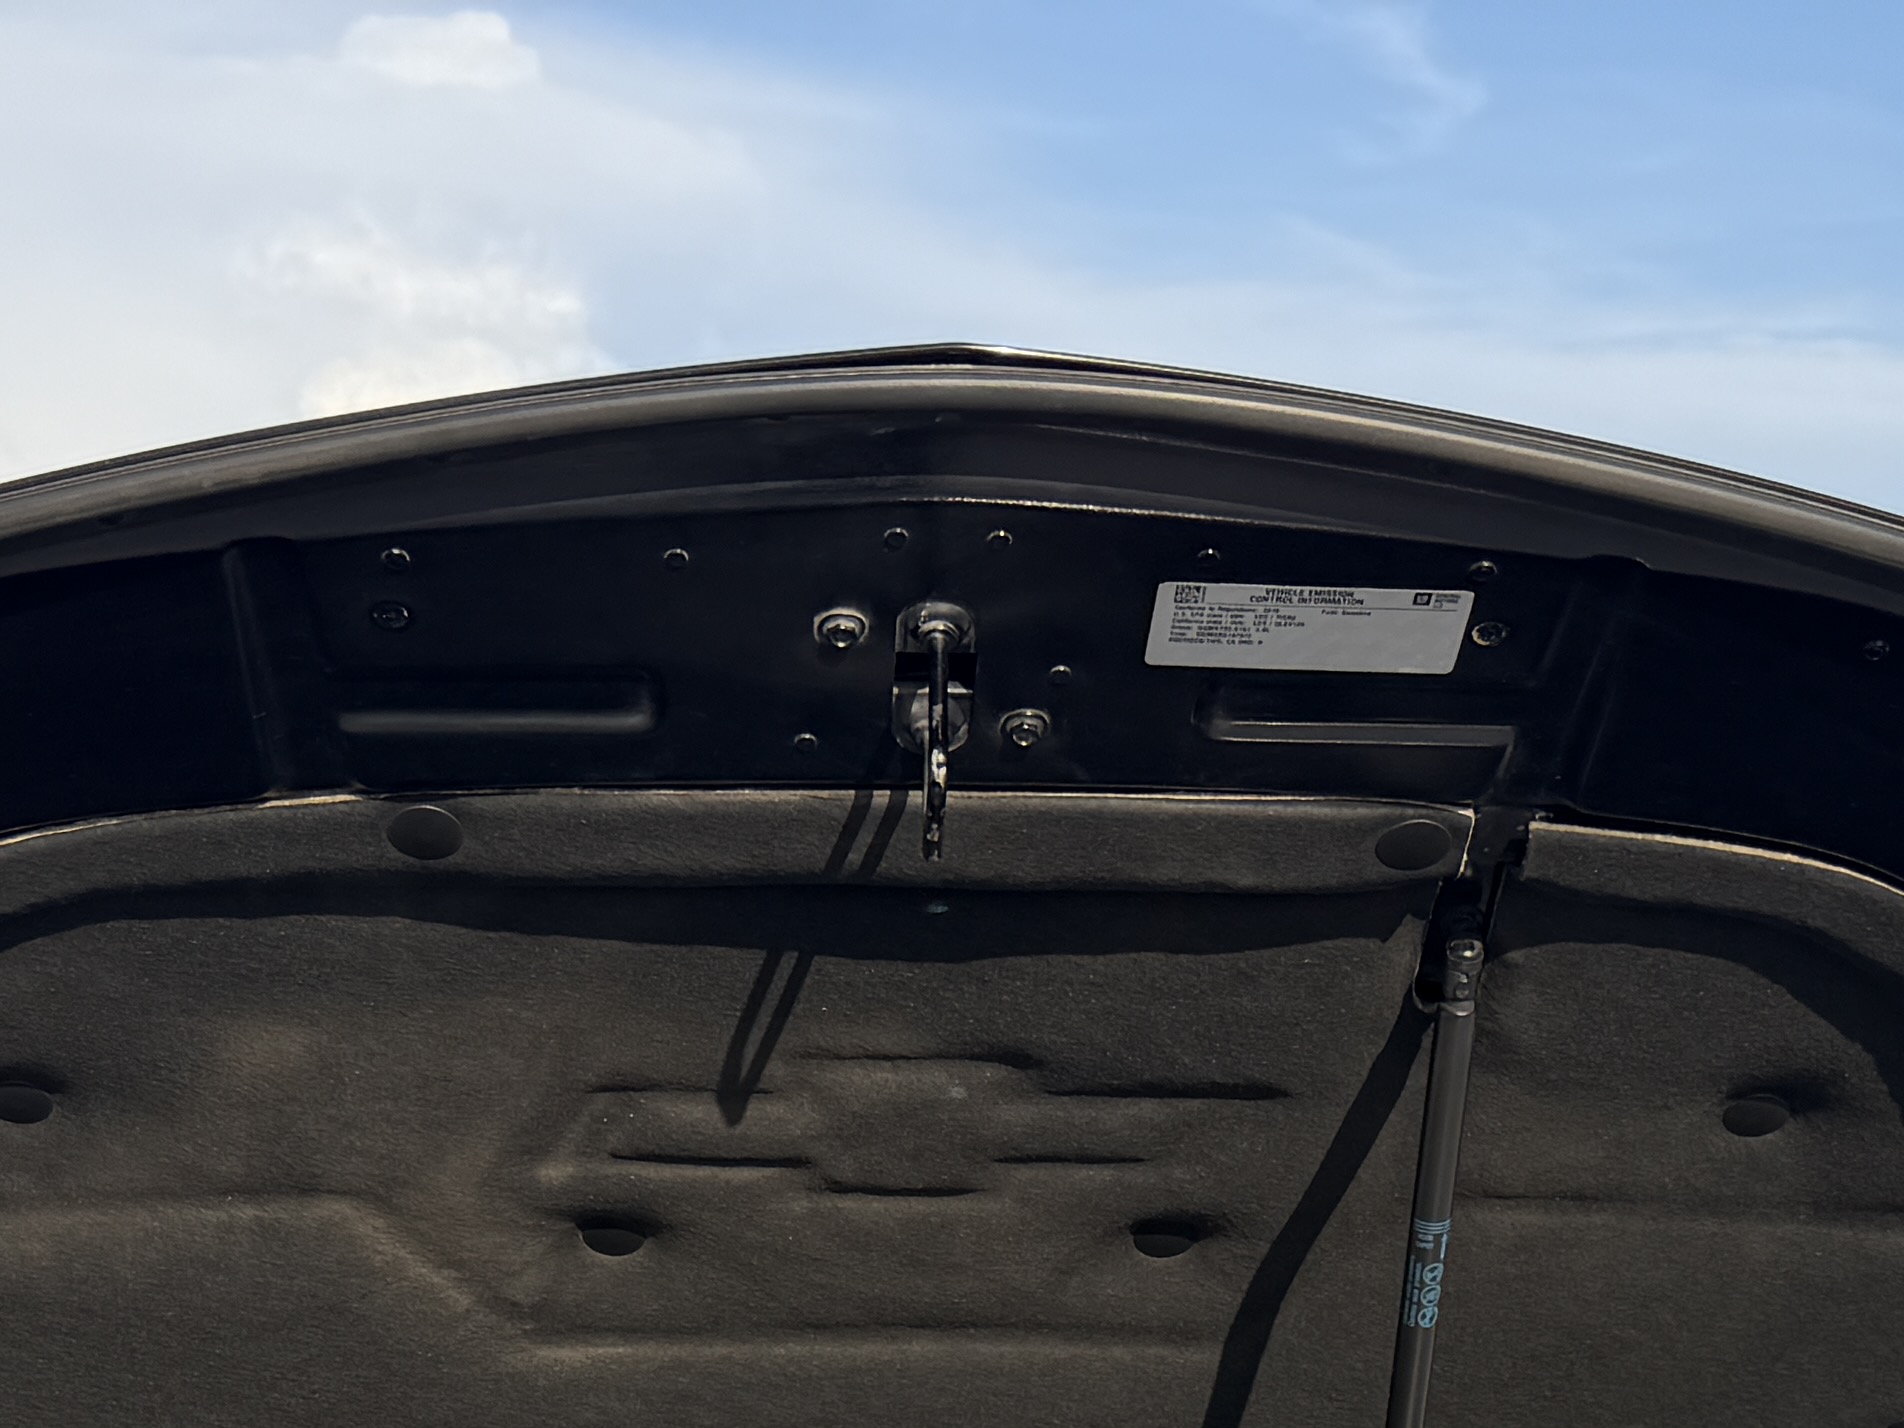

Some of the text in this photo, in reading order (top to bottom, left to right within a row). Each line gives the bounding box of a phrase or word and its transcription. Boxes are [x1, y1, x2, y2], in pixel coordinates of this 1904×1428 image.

[1265, 588, 1355, 598] VEHICLE EMISSION
[1249, 595, 1364, 606] CONTROL INFORMATION
